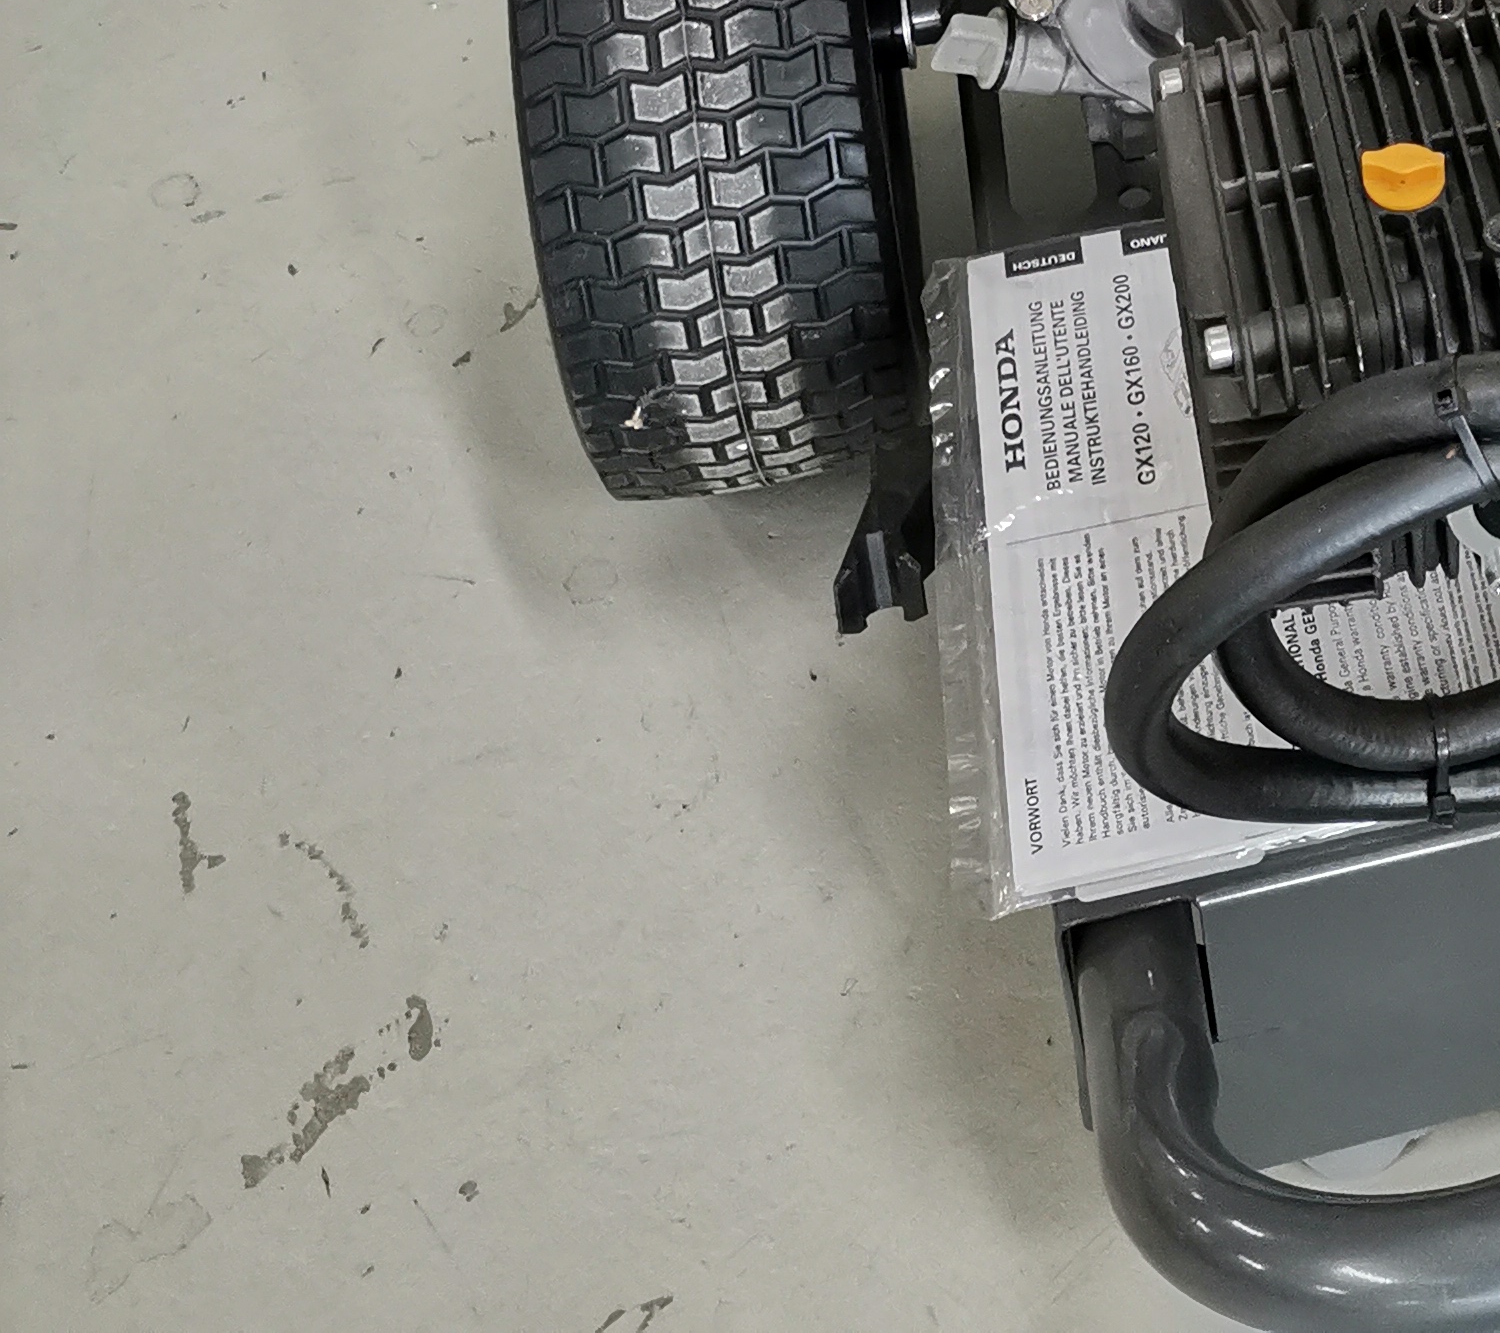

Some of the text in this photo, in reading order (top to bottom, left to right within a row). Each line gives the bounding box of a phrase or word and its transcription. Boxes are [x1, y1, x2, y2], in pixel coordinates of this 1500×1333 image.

[1129, 233, 1168, 250] IANO
[1012, 251, 1076, 272] DEUTSCH
[1049, 299, 1083, 483] MANUALE DELL'UTENTE
[1070, 289, 1107, 485] INSTRUKTIEHANDLEIDING
[1112, 273, 1157, 486] GX120 GX160 GX200
[993, 327, 1026, 473] HONDA
[1028, 299, 1061, 491] BEDIENUNGSANLEITUNG
[1060, 556, 1071, 583] Dieses
[1073, 565, 1083, 579] Sie
[1099, 583, 1111, 609] Motor
[1040, 608, 1051, 635] Honda
[1396, 583, 1431, 686] warranty conditions
[1414, 584, 1441, 657] or specificatio
[1042, 637, 1053, 653] von
[1092, 625, 1104, 655] Betrieb
[1326, 602, 1350, 679] General Purpo
[1343, 601, 1368, 683] Honda warranty
[1367, 598, 1397, 691] warranty conditio
[1383, 599, 1411, 675] established by
[1068, 640, 1079, 666] sicher
[1044, 655, 1055, 681] Motor
[1073, 683, 1083, 700] und
[1049, 709, 1059, 722] für
[1061, 695, 1072, 719] dabei
[1086, 688, 1102, 751] diesbezügliche
[1050, 723, 1061, 742] sich
[1078, 737, 1088, 748] zu
[1052, 744, 1063, 758] Sie
[1079, 750, 1091, 778] Motor
[1053, 761, 1065, 783] dass
[1066, 747, 1079, 788] möchten
[1093, 754, 1105, 786] enthält
[1056, 784, 1068, 813] Dank,
[1070, 790, 1081, 808] Wir
[1082, 780, 1094, 810] neuen
[1123, 793, 1135, 813] sich
[1024, 776, 1043, 854] VORWORT
[1096, 787, 1111, 838] Handbuch
[1110, 788, 1125, 835] sorgfältig
[1126, 815, 1137, 832] Sie
[1058, 816, 1071, 847] Vielen
[1085, 812, 1097, 841] Ihrem
